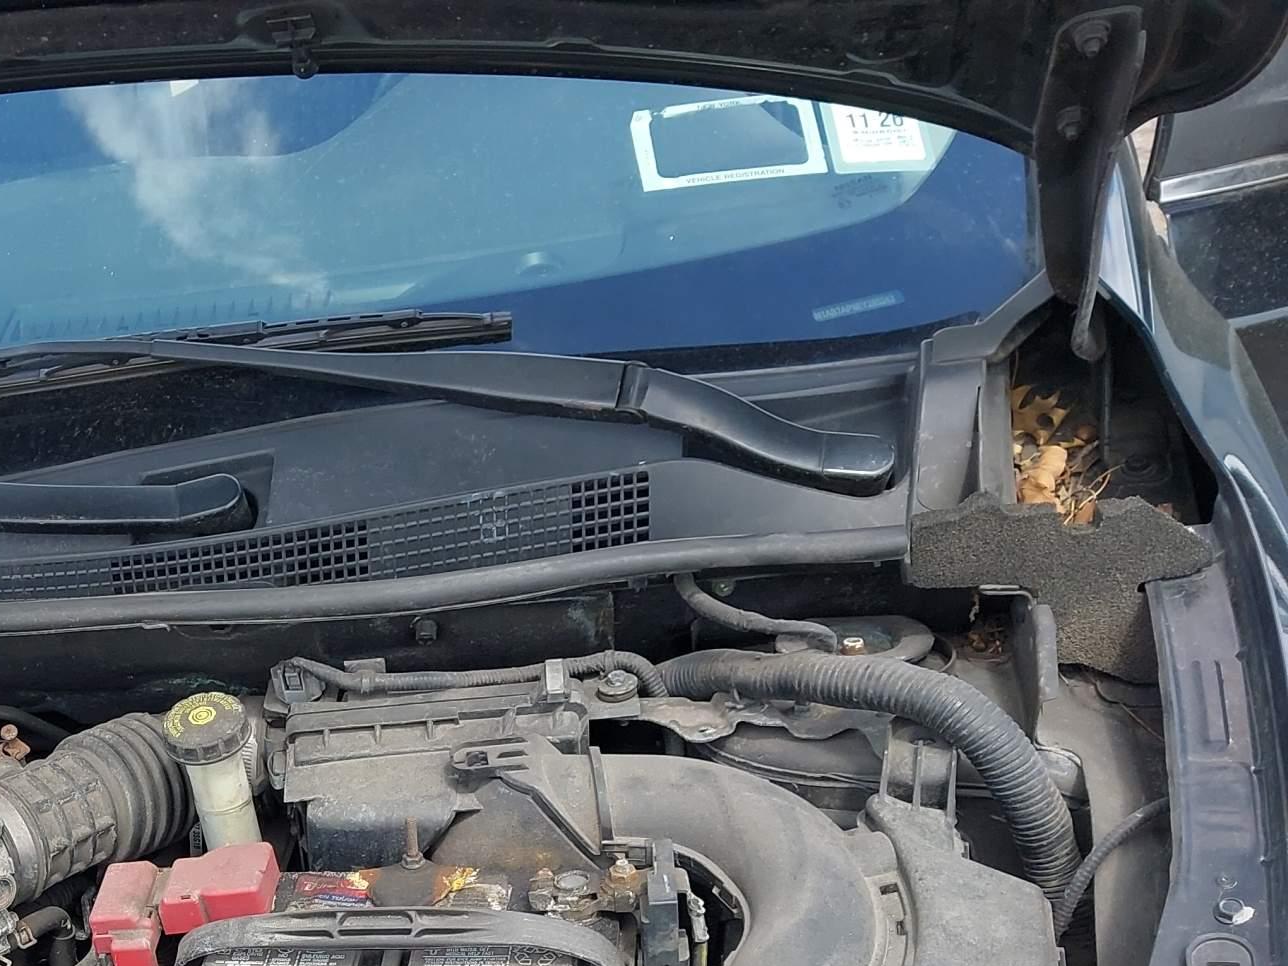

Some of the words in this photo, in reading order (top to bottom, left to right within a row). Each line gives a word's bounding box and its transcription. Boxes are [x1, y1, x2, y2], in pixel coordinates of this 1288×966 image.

[846, 112, 869, 128] 11
[686, 173, 722, 184] VEHICLE
[723, 168, 786, 181] REGISTRATION
